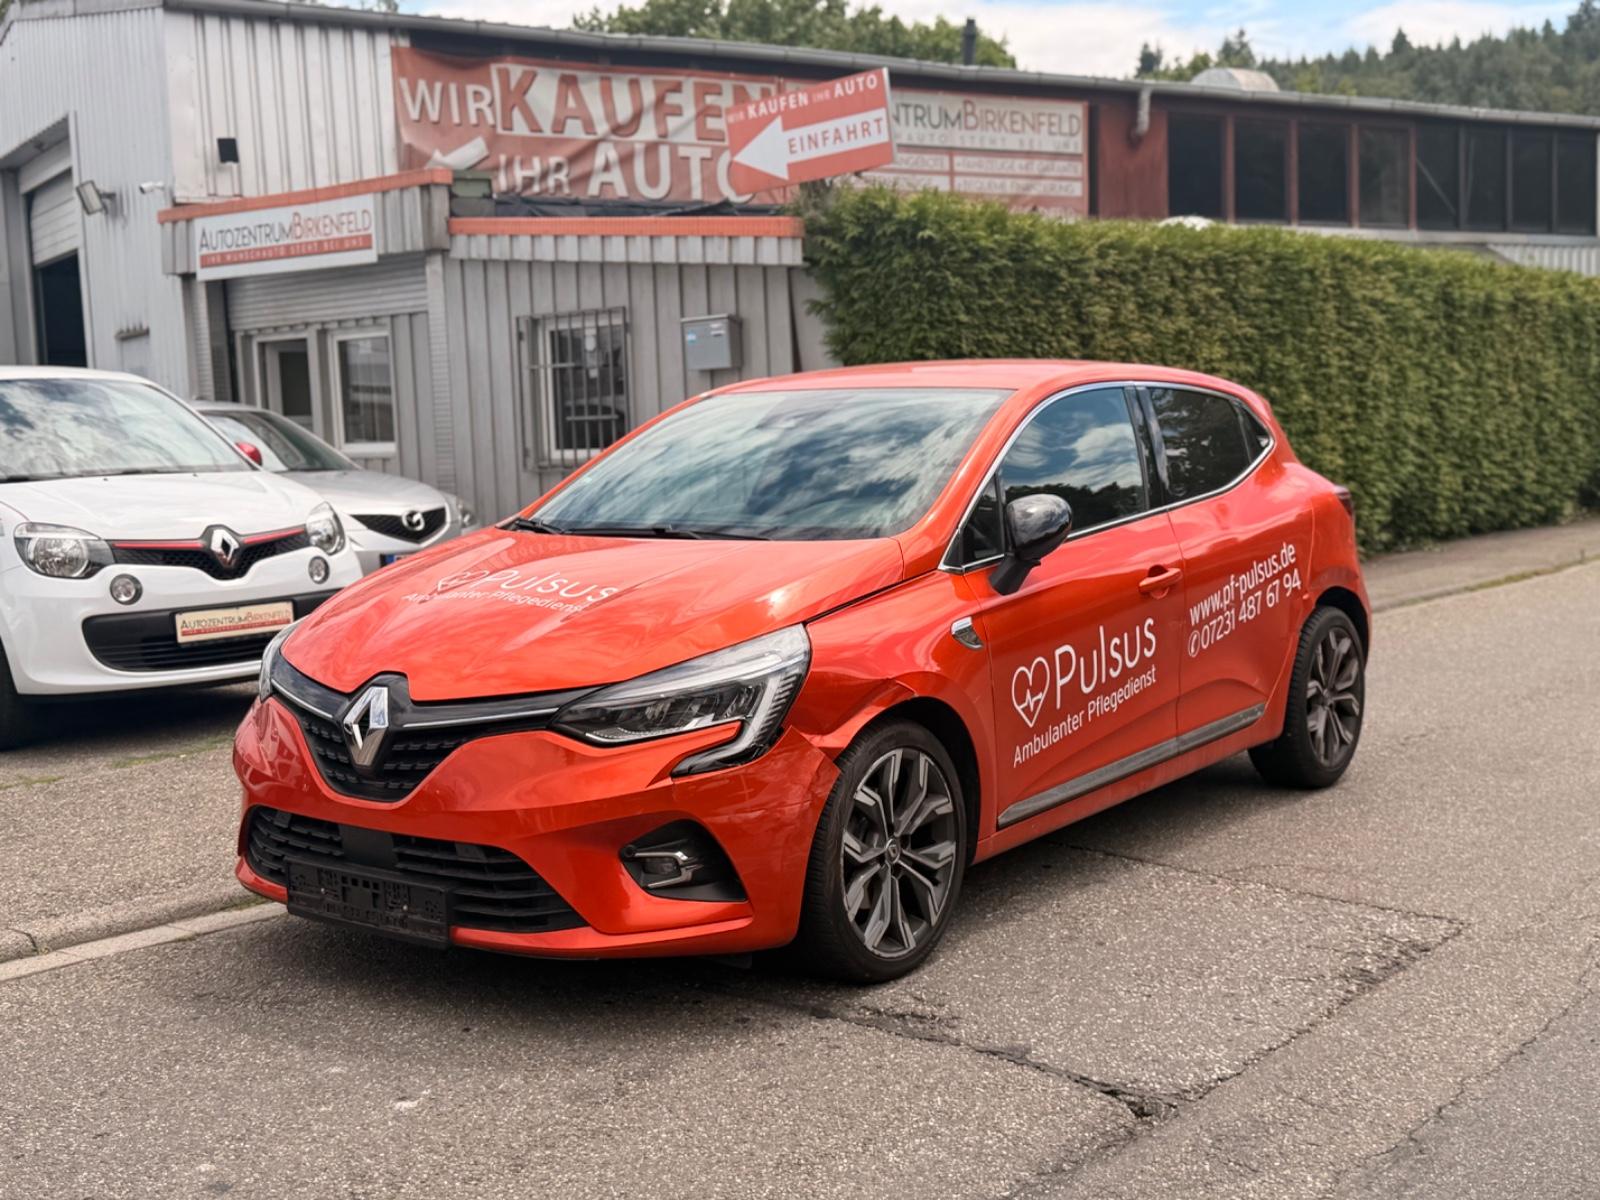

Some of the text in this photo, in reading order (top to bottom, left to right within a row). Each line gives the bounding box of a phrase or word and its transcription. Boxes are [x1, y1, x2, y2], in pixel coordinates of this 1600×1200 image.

[400, 76, 496, 127] WIR
[747, 92, 809, 119] KAUFEN
[834, 74, 878, 98] AUTO
[892, 99, 1081, 137] NTRUMBIRKENFELD
[788, 117, 884, 155] EINFAHRT
[500, 153, 571, 195] IHR
[470, 569, 619, 602] Pulsus
[1189, 542, 1297, 626] www.pf-pulsus.de
[1200, 568, 1302, 650] 07231 487 67 94
[1054, 617, 1157, 710] Pulsus
[1013, 664, 1157, 768] Ambulanter Pflegedienst
